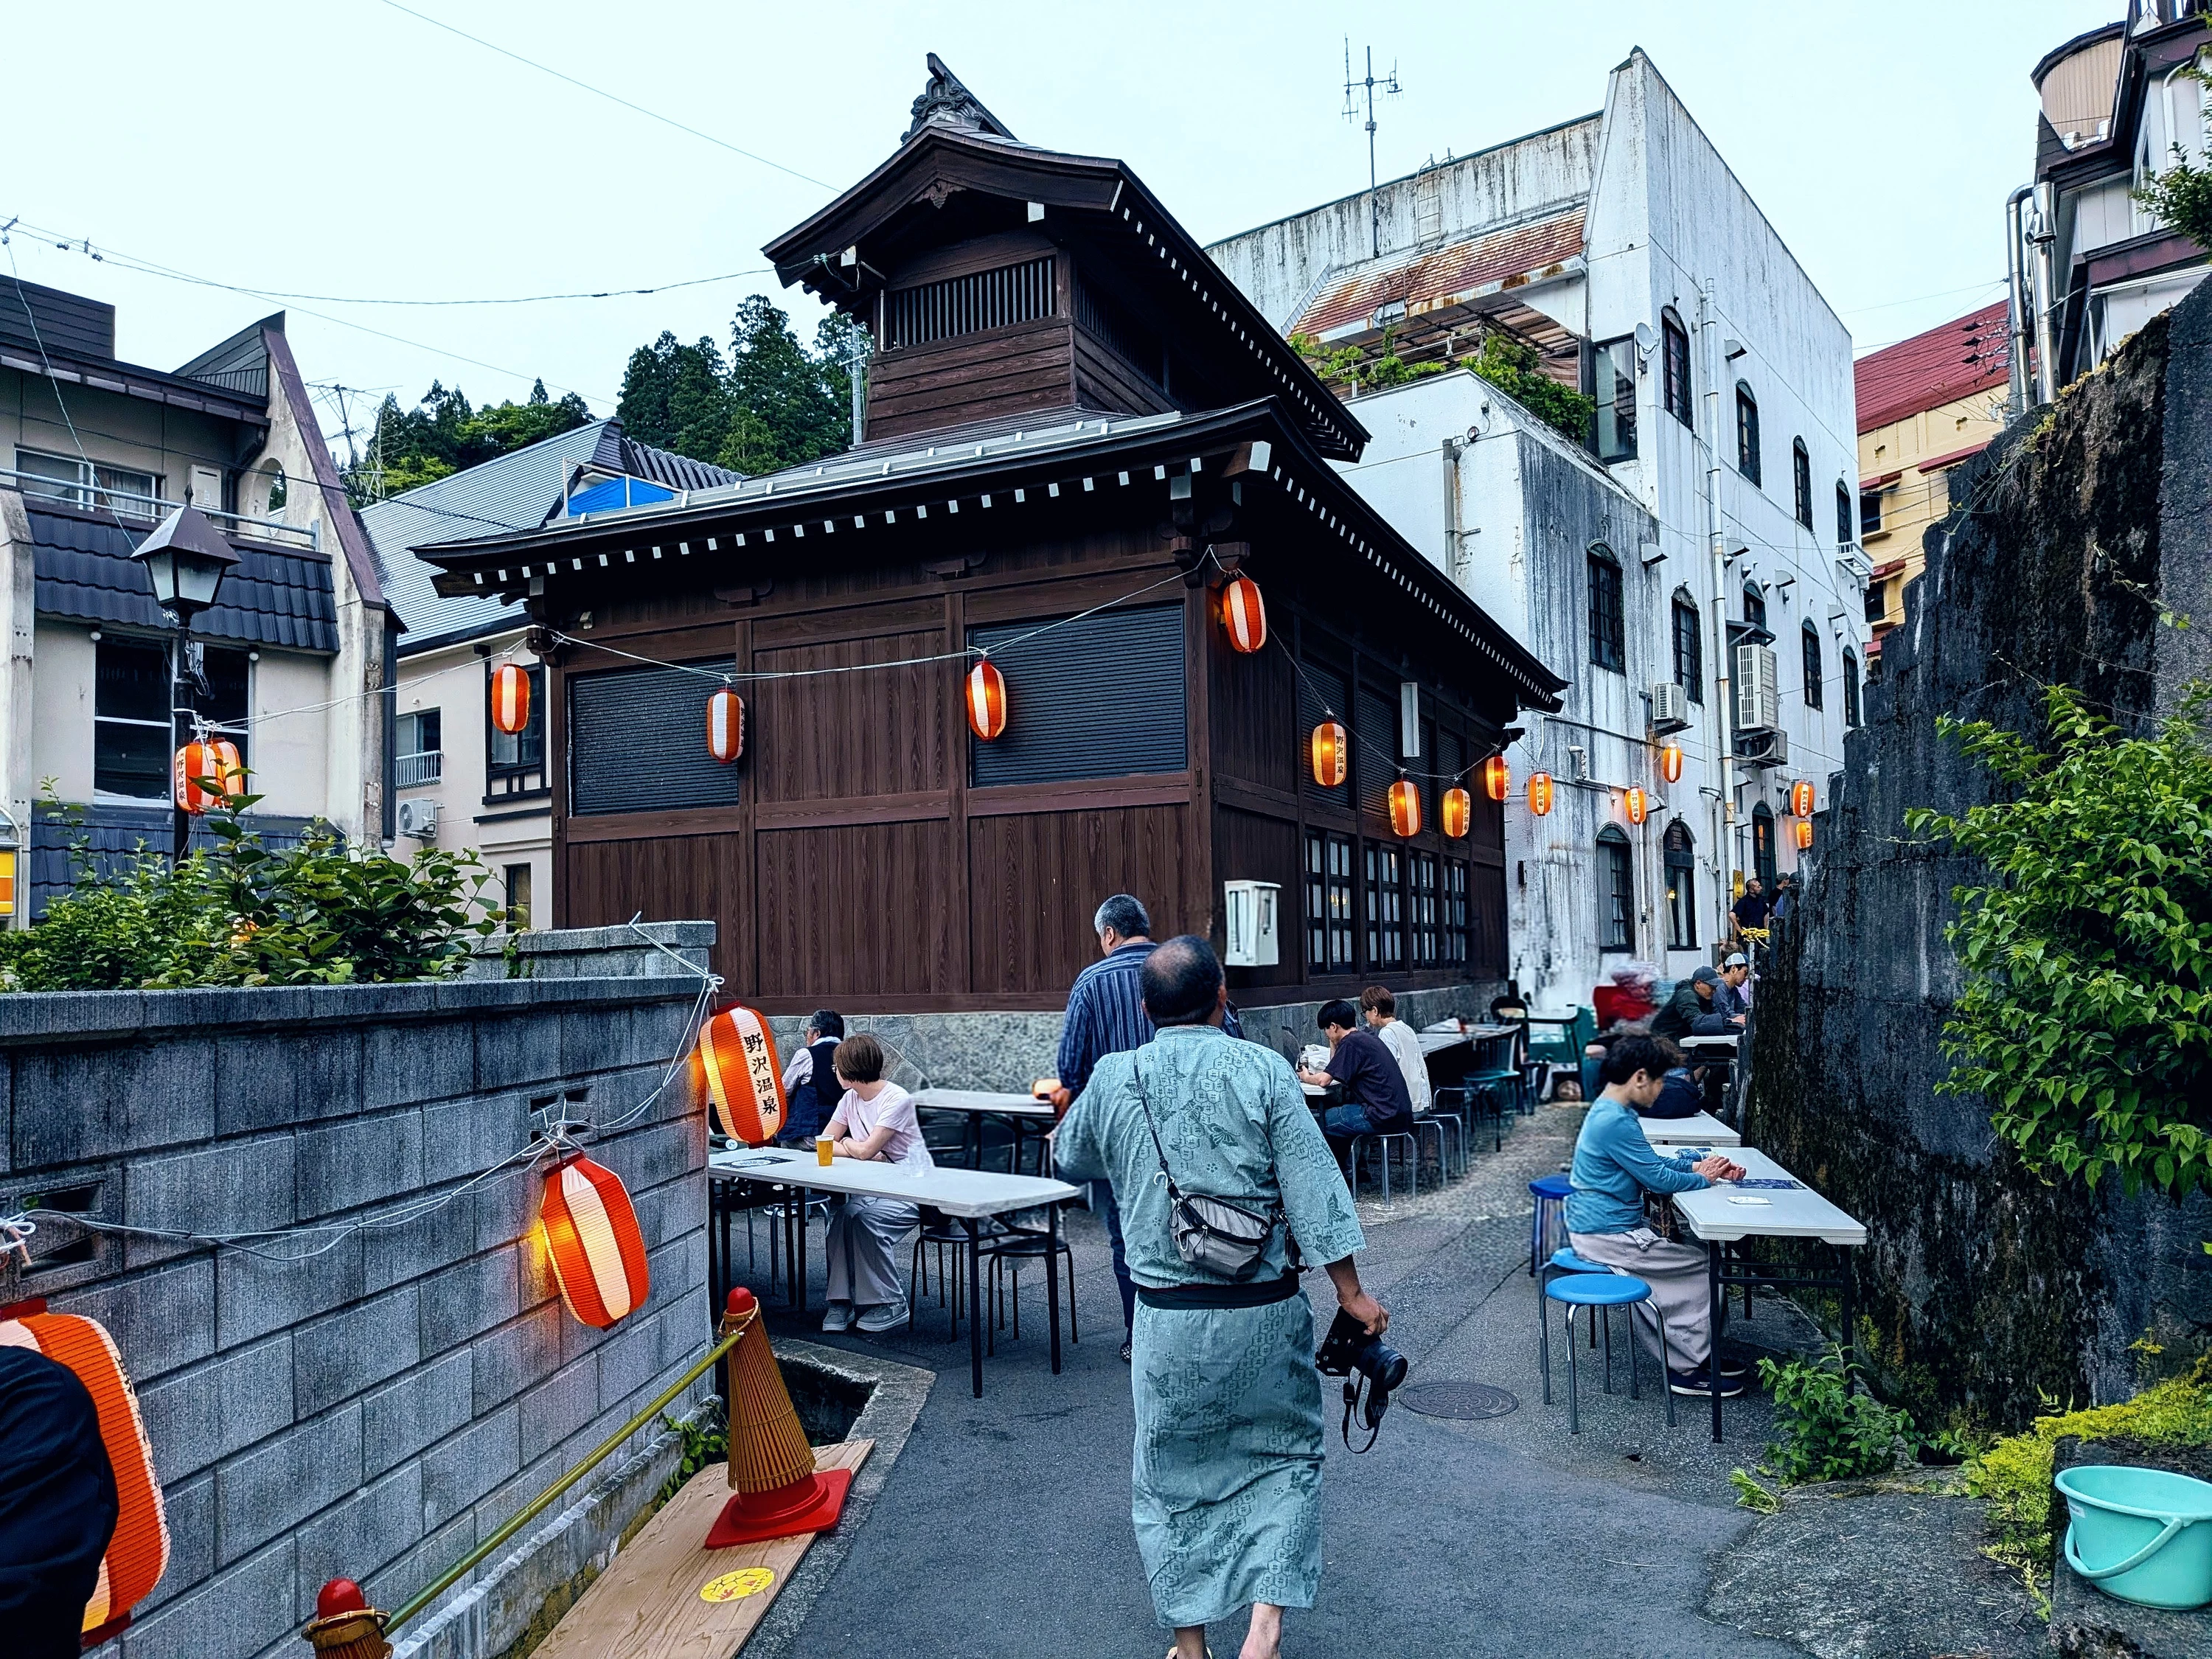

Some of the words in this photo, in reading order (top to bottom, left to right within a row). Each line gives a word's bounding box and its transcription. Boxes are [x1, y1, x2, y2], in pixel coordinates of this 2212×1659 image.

[1335, 735, 1344, 774] 野沢温泉
[177, 759, 186, 801] 野沢温泉
[742, 1032, 779, 1116] 野沢温泉
